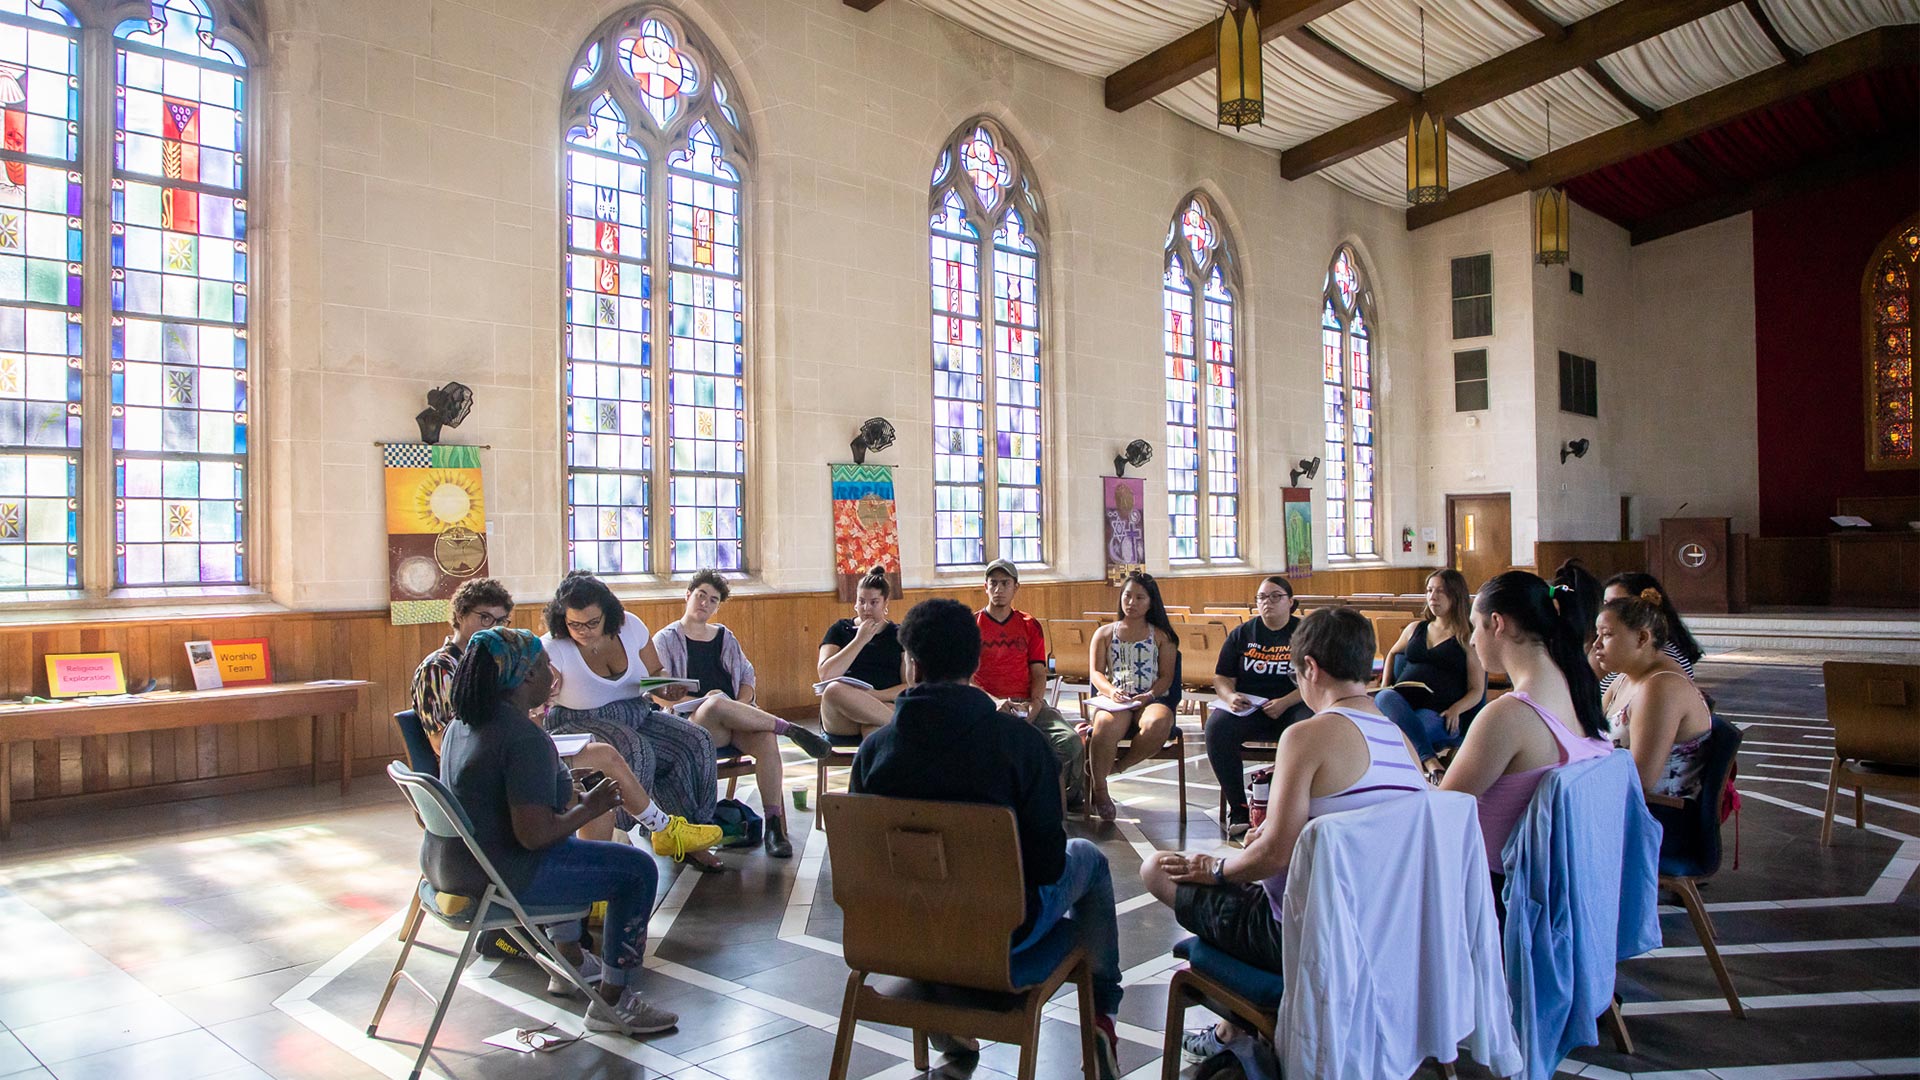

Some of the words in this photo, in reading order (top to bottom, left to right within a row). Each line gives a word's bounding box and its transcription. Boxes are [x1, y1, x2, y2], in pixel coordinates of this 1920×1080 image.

[220, 652, 257, 661] Worship
[1243, 648, 1292, 660] America
[66, 665, 104, 673] Religious
[1243, 657, 1297, 674] VOTES
[63, 674, 111, 682] Exploration
[495, 937, 518, 955] URGENT
